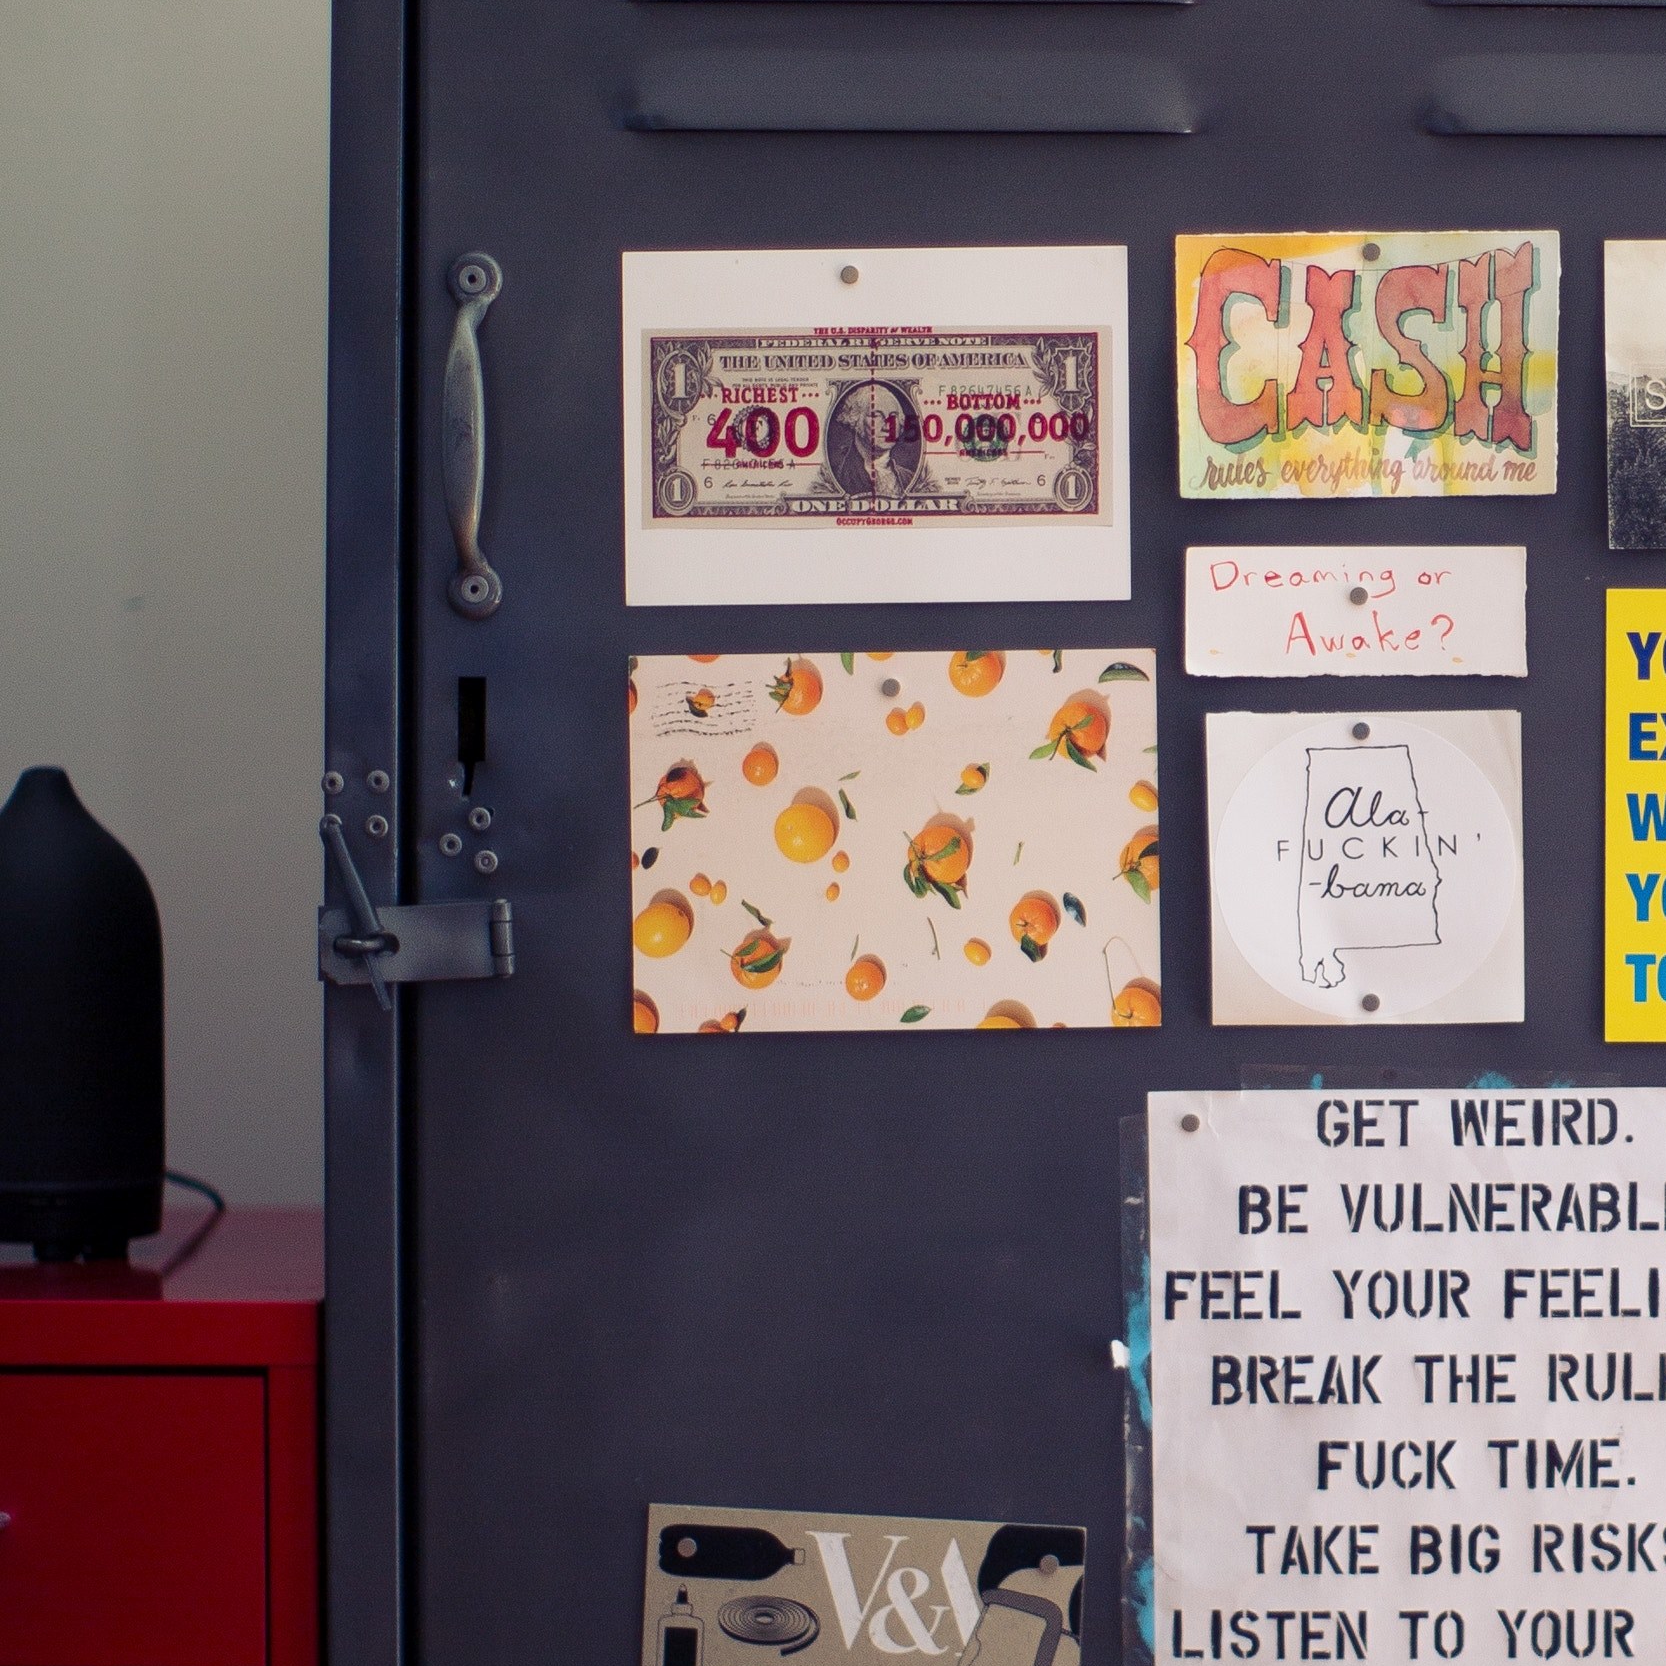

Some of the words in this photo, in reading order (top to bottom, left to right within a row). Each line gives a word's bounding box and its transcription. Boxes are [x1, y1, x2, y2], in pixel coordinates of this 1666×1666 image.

[720, 353, 762, 370] THE
[764, 353, 835, 370] UNITED
[838, 353, 909, 369] STATES
[911, 353, 938, 369] OF
[938, 352, 1031, 369] AMERICA
[760, 339, 849, 348] FEDERAL
[938, 337, 988, 346] NOTE
[1186, 241, 1540, 452] CASH
[721, 388, 799, 404] RICHEST
[946, 393, 1021, 411] BOTTOM
[706, 406, 820, 459] 400
[884, 411, 1090, 447] 150,000,000
[703, 476, 714, 489] 6
[1036, 474, 1047, 487] 6
[1189, 453, 1271, 490] rules
[1281, 451, 1405, 494] everything
[1414, 453, 1498, 484] around
[1503, 460, 1537, 481] me
[791, 499, 847, 513] ONE
[850, 498, 960, 512] DOLLAR
[1210, 560, 1396, 599] Dreaming
[1417, 569, 1452, 586] or
[1286, 611, 1455, 656] Awake?
[1309, 863, 1426, 898] -bama
[1317, 1098, 1419, 1147] GET
[1450, 1097, 1635, 1147] WEIRD.
[1238, 1184, 1308, 1234] BE
[1164, 1270, 1301, 1320] FEEL
[1333, 1269, 1470, 1319] YOUR
[1211, 1354, 1383, 1406] BREAK
[1414, 1354, 1517, 1403] THE
[1317, 1440, 1456, 1490] FUCK
[1487, 1439, 1636, 1489] TIME.
[1245, 1525, 1380, 1575] TAKE
[1409, 1523, 1501, 1575] BIG
[1171, 1610, 1369, 1660] LISTEN
[1399, 1609, 1465, 1659] TO
[1496, 1608, 1635, 1659] YOUR
